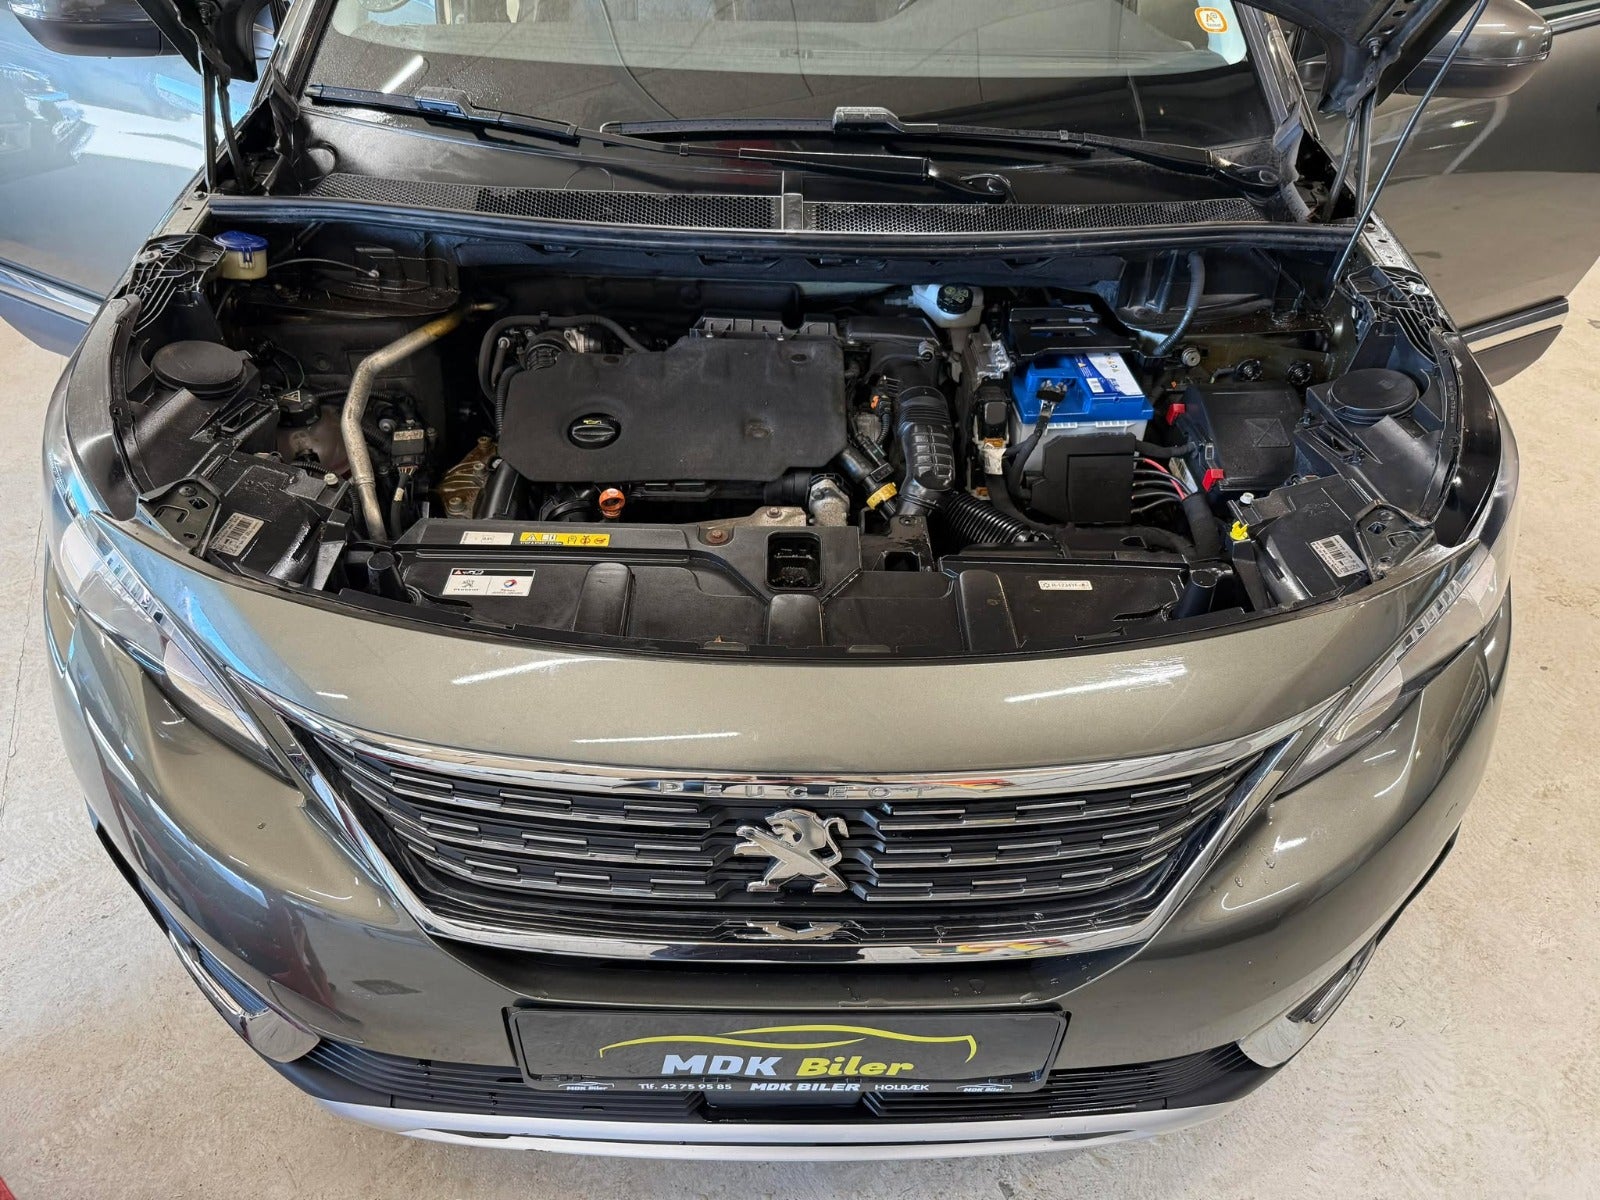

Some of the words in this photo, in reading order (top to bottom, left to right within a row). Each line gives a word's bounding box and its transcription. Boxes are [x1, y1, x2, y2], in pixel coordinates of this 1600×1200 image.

[661, 1054, 783, 1076] MDK
[796, 1055, 914, 1077] Biler
[661, 1083, 677, 1091] 42
[679, 1083, 696, 1091] 75
[698, 1083, 714, 1091] 95
[717, 1083, 732, 1091] 85
[750, 1082, 792, 1092] MDK
[796, 1082, 861, 1092] BILER
[874, 1084, 930, 1092] HOLBÆK
